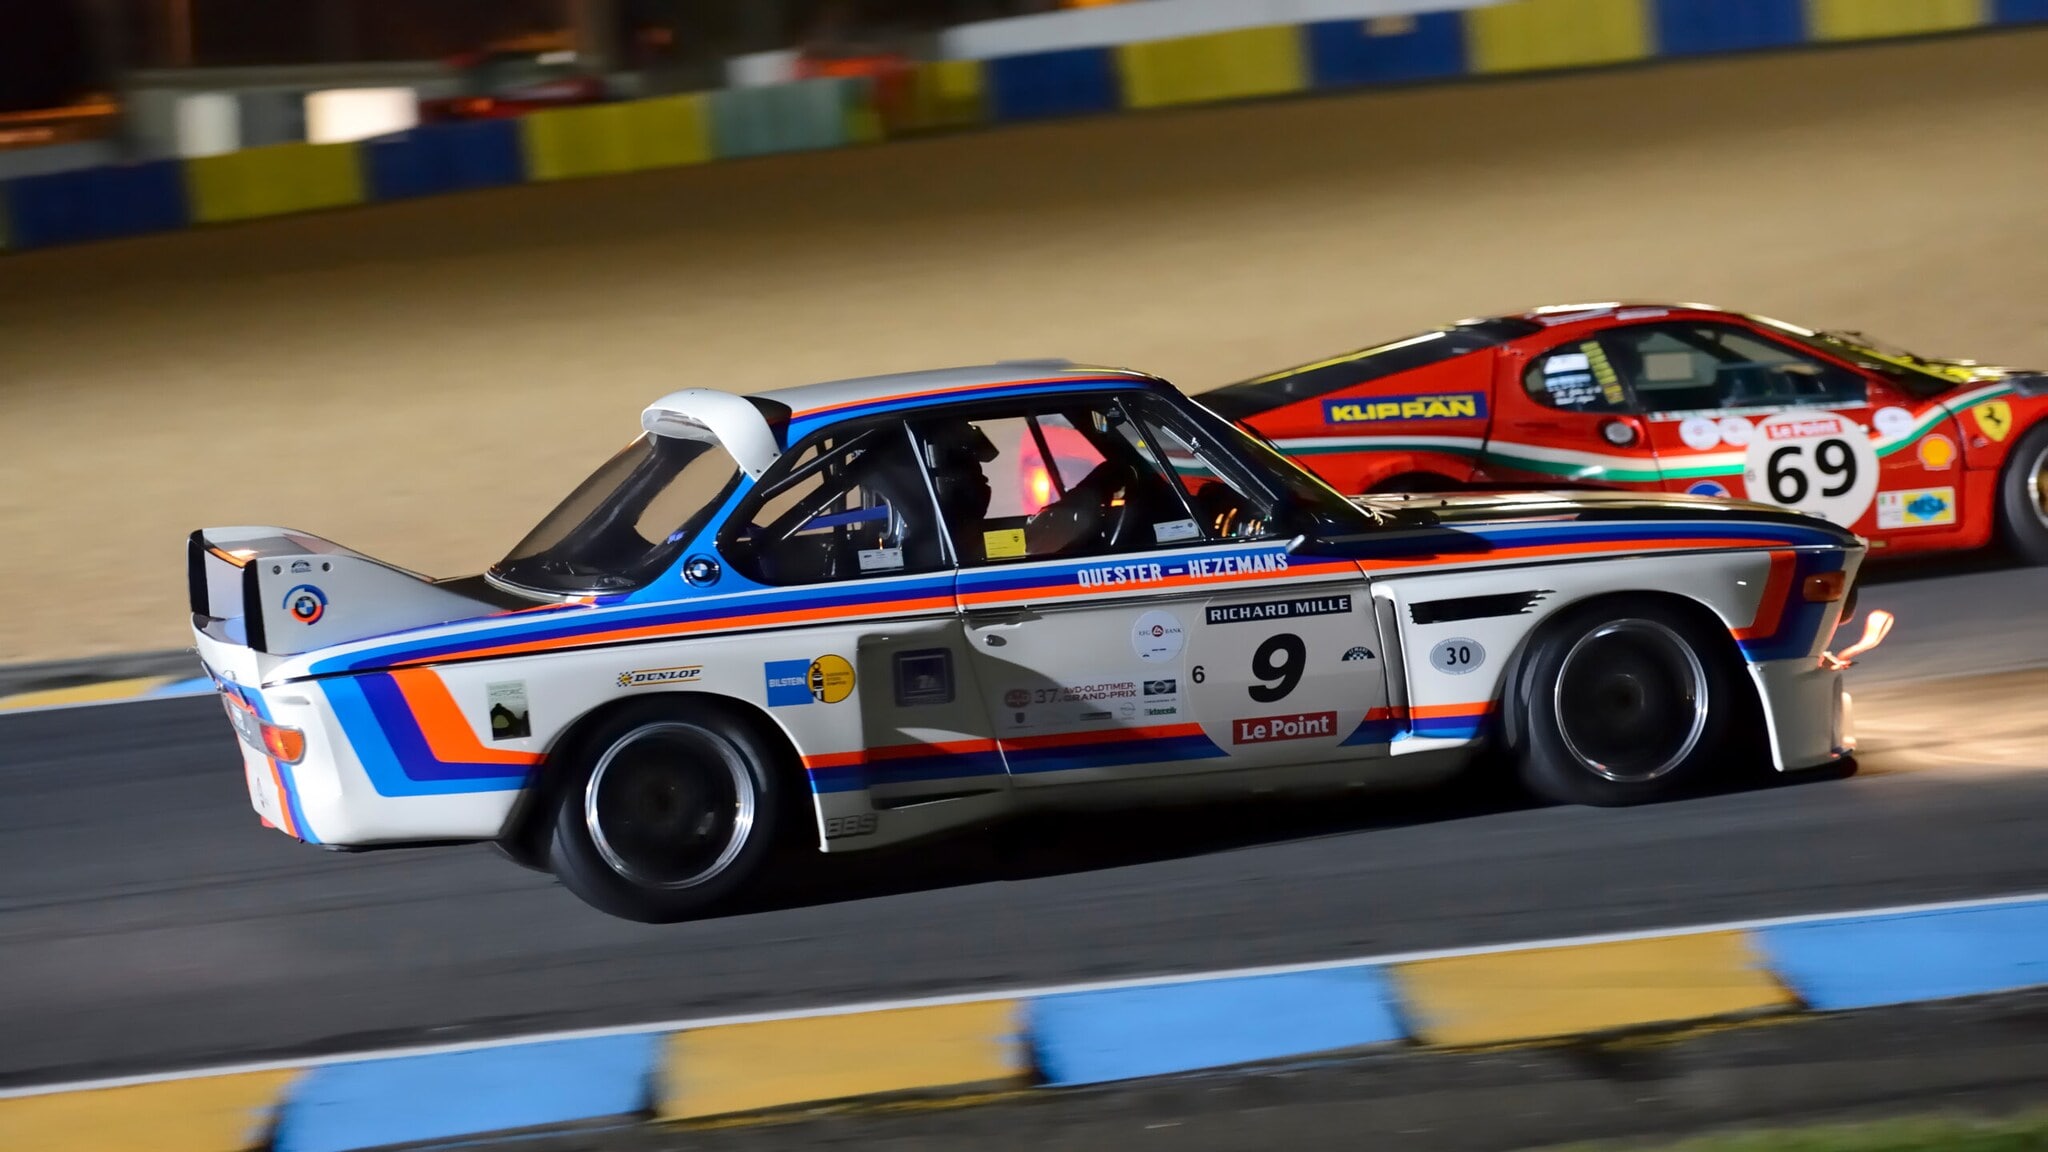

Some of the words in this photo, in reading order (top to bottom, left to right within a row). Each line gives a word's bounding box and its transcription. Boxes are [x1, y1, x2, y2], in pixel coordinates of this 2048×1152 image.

[1331, 400, 1477, 422] KLIPPAN
[1769, 423, 1793, 439] Le
[1795, 419, 1839, 437] Point
[1766, 438, 1857, 505] 69
[1077, 563, 1163, 588] QUESTER
[1189, 553, 1289, 579] HEZEMANS
[1210, 603, 1290, 622] RICHARD
[1295, 598, 1349, 614] MILLE
[1446, 645, 1471, 666] 30
[634, 669, 701, 682] DUNLOP
[1192, 665, 1206, 684] 6
[1248, 633, 1307, 703] 9
[768, 676, 806, 688] BILSTEIN
[1062, 690, 1137, 702] GRAND-PRIX
[1241, 722, 1266, 741] Le
[1271, 715, 1330, 738] Point
[825, 813, 879, 840] BBS
